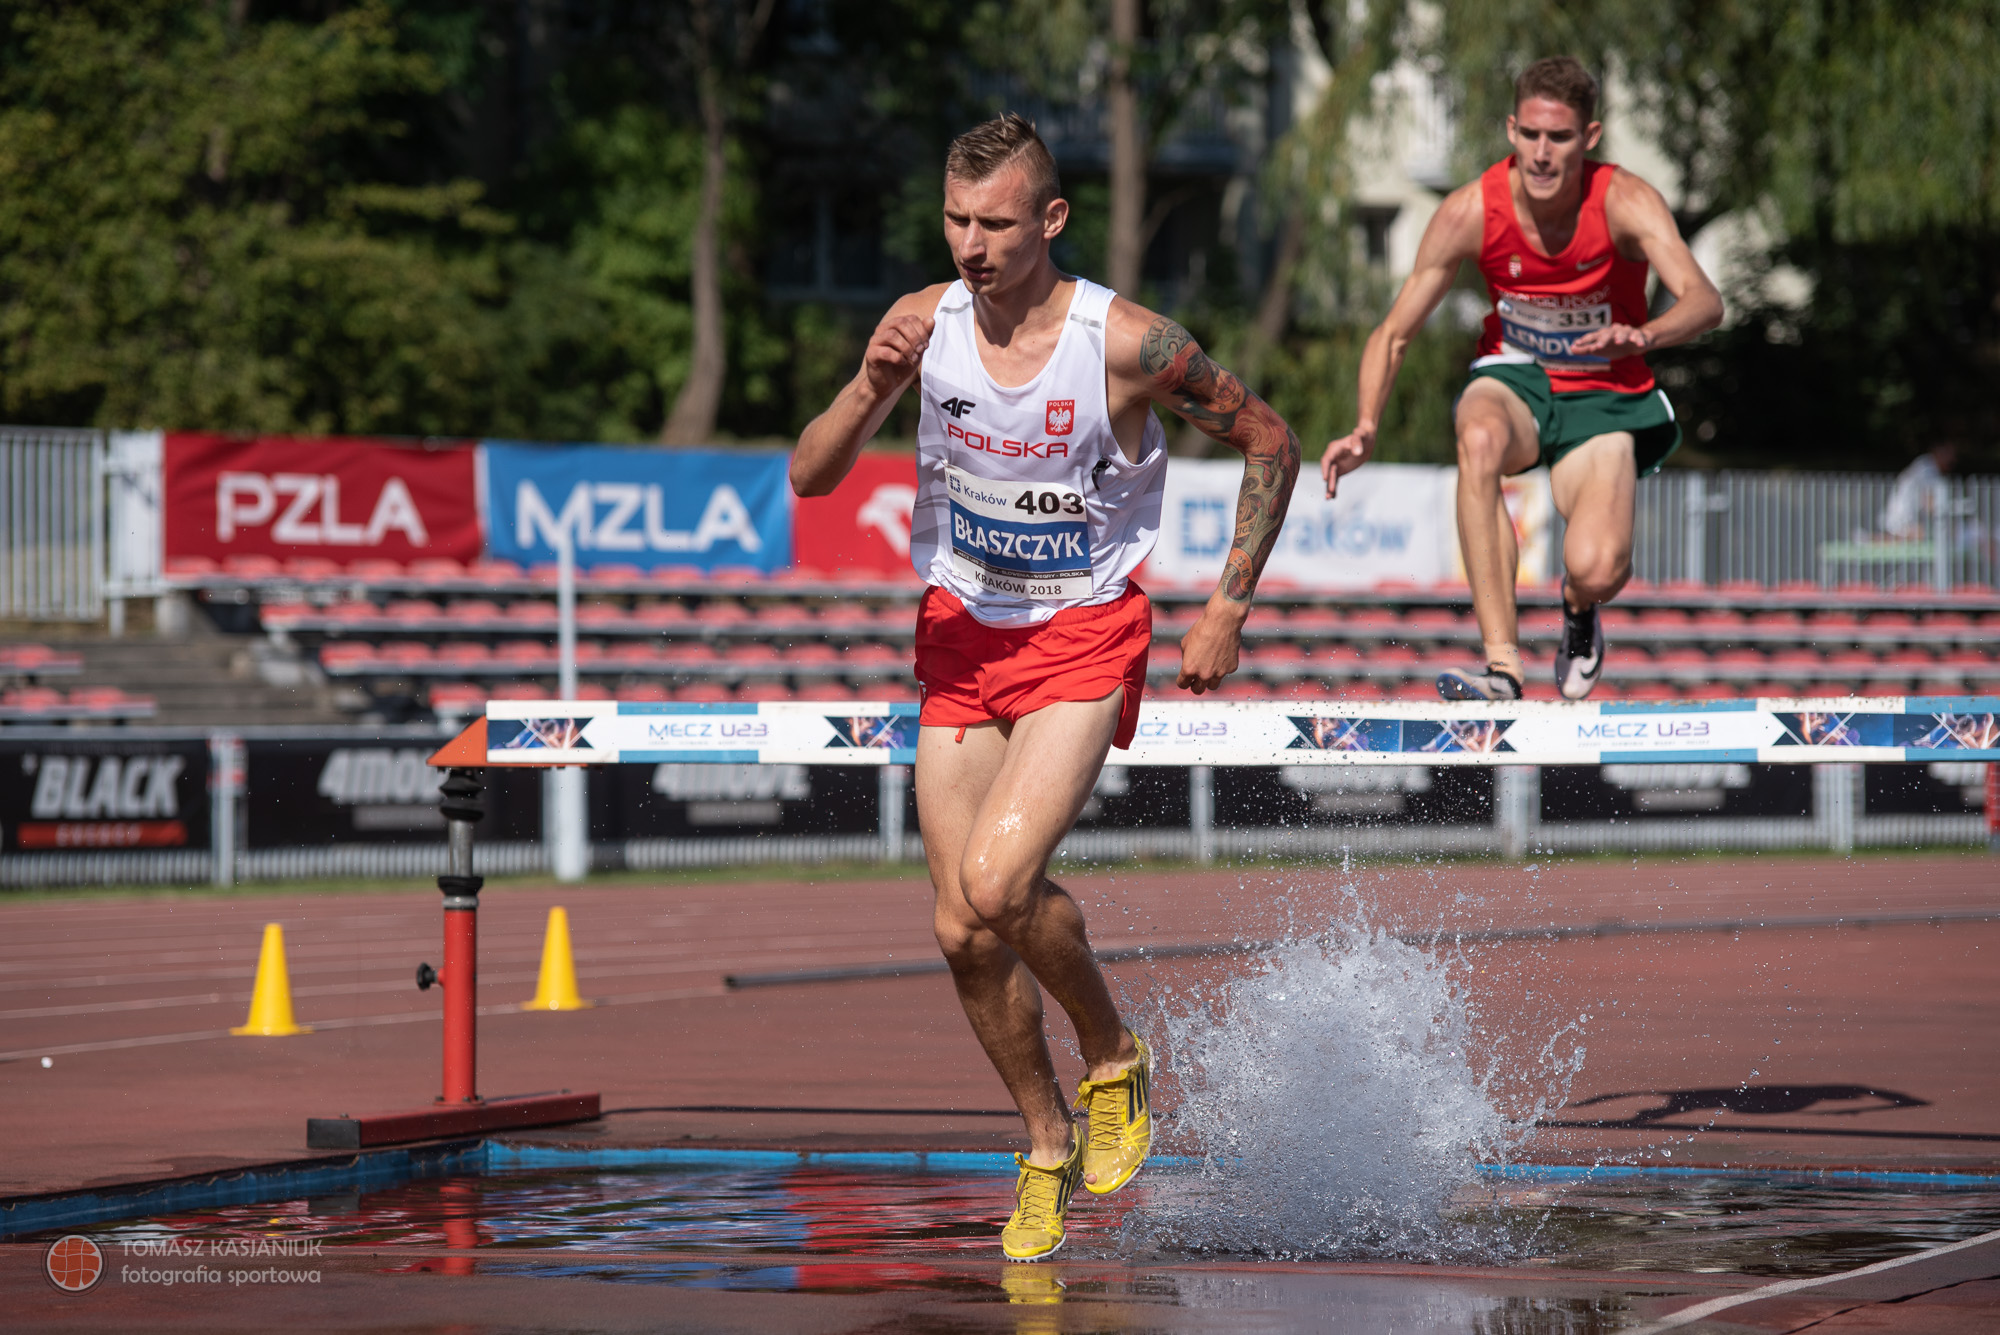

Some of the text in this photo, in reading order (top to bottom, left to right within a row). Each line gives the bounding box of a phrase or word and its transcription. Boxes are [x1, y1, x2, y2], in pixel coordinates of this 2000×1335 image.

[1559, 310, 1606, 327] 331
[1506, 324, 1577, 356] LENDV
[941, 397, 976, 419] 4F
[947, 423, 1069, 458] POLSKA
[217, 471, 428, 545] PZLA
[964, 485, 1084, 515] Kraków 403
[516, 479, 761, 553] MZLA
[954, 512, 1084, 561] BŁASZCZYK
[975, 570, 1062, 596] KRAKÓW 2018
[649, 723, 768, 737] MECZ U23
[1177, 722, 1228, 736] U23
[1577, 721, 1710, 738] MECZ U23
[31, 754, 185, 819] BLACK
